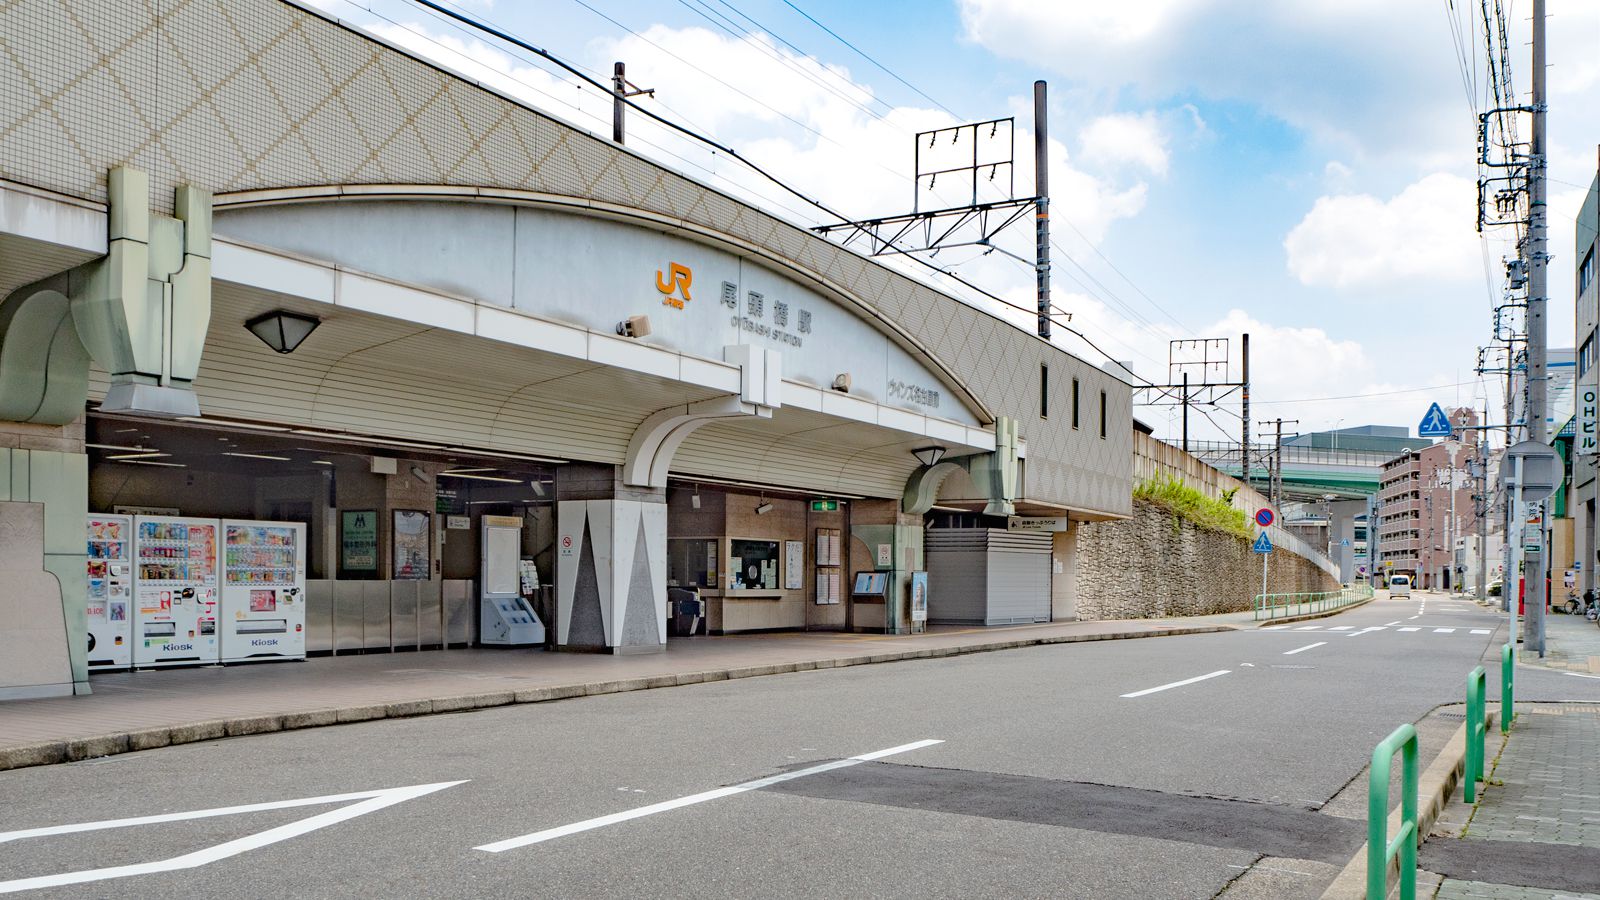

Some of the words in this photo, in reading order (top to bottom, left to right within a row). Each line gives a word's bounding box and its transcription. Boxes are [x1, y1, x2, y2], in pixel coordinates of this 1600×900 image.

[655, 261, 692, 301] JR
[720, 280, 812, 335] 尾頭橋駅
[772, 329, 802, 348] STATION
[1583, 391, 1596, 449] OHビル
[163, 643, 193, 651] Kiosk
[251, 638, 279, 647] Kiosk
